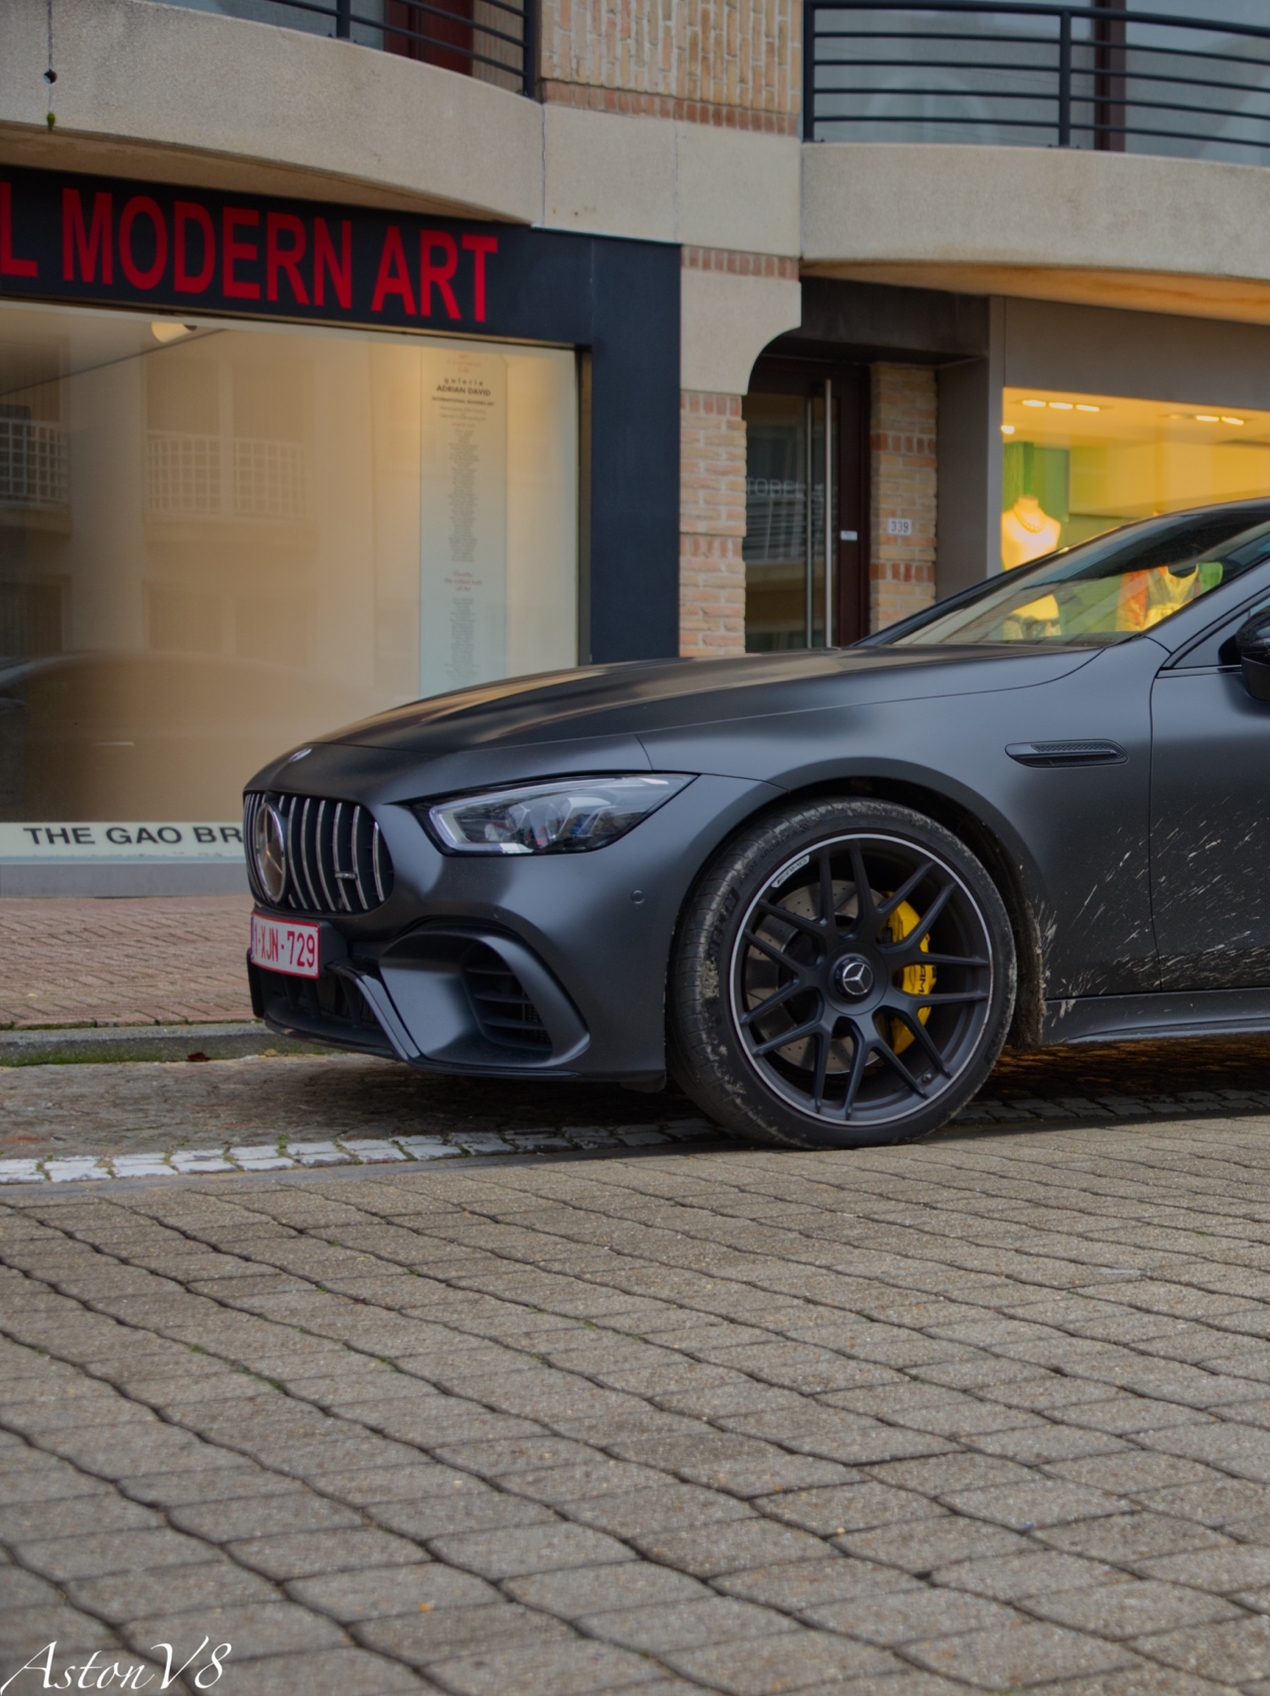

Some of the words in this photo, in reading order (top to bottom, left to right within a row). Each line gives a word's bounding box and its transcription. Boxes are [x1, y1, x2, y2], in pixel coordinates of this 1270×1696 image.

[62, 187, 353, 310] MODERN
[371, 225, 499, 323] ART
[436, 384, 466, 394] ADRIAN
[467, 387, 491, 396] DAVID
[890, 520, 909, 532] 339
[23, 827, 95, 845] THE
[106, 826, 183, 845] GAO
[193, 827, 243, 844] BR
